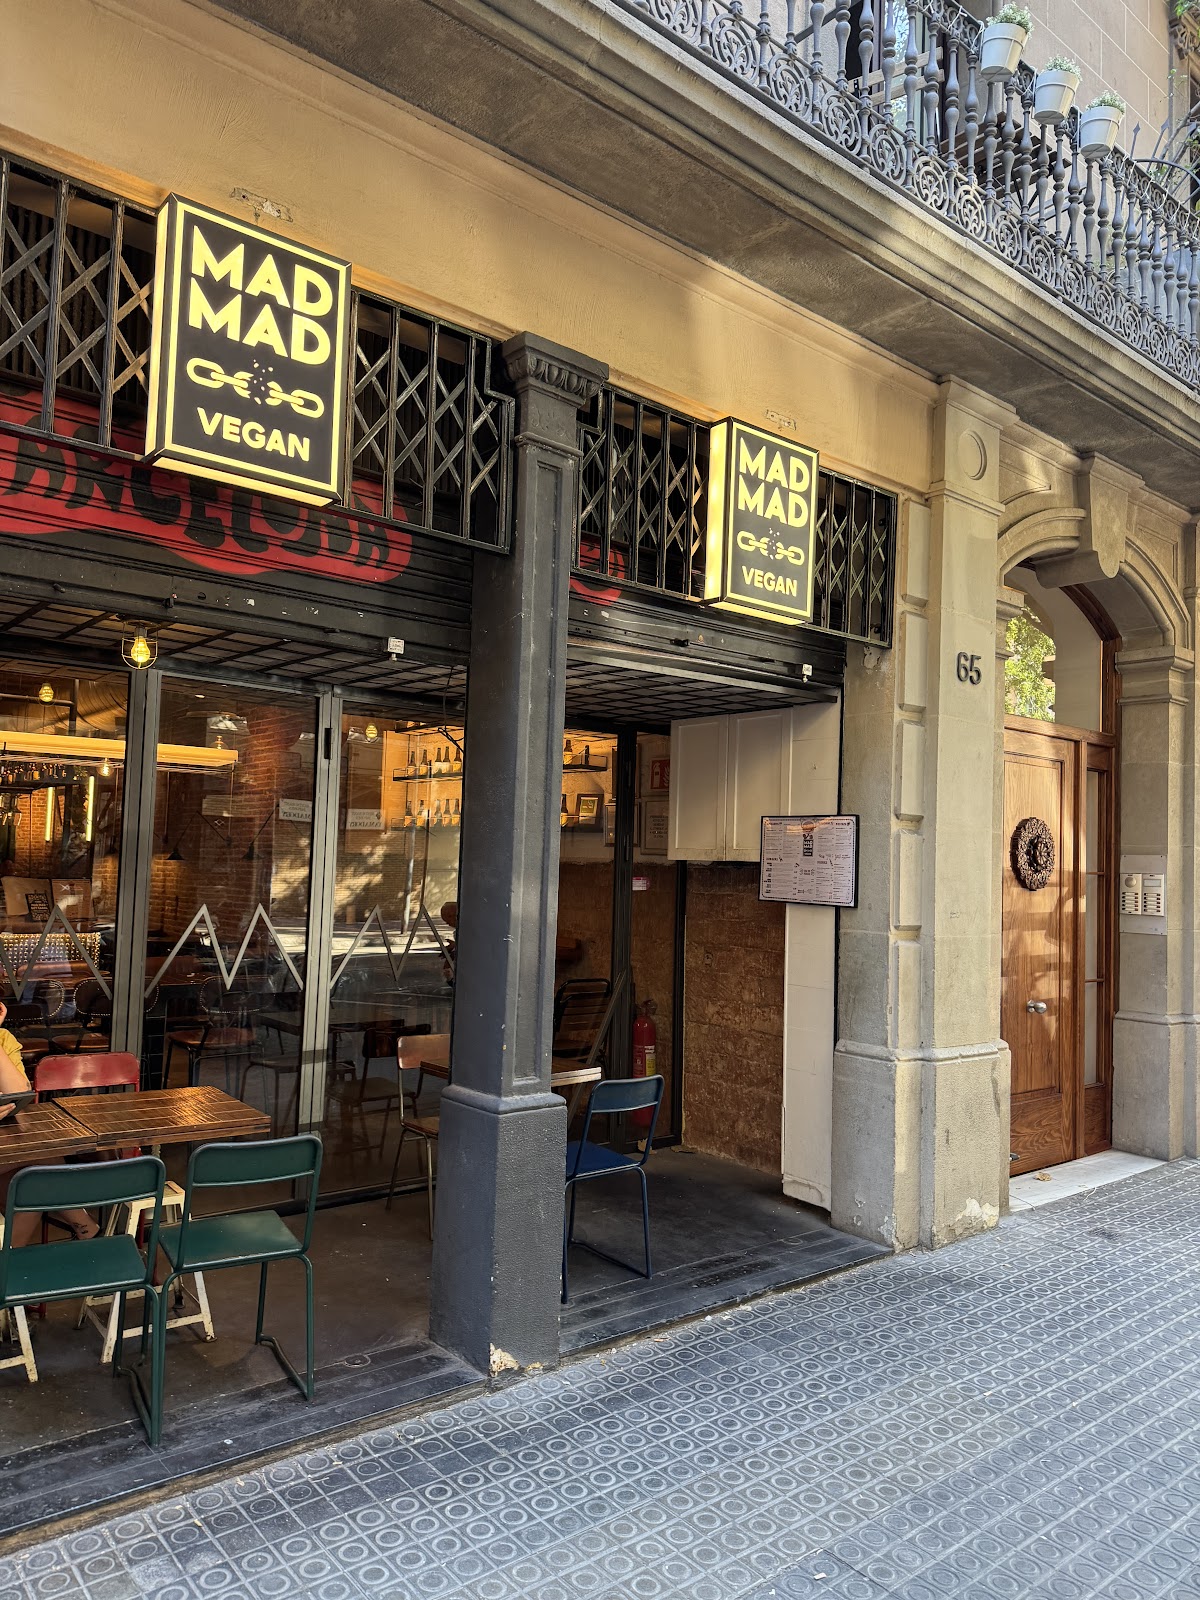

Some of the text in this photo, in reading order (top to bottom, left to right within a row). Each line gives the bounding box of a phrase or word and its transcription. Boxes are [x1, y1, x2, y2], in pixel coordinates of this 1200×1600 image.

[191, 225, 334, 317] MAD
[188, 277, 331, 365] MAD
[196, 406, 310, 462] VEGAN
[739, 437, 810, 492] MAD
[737, 475, 809, 528] MAD
[742, 566, 798, 597] VEGAN
[956, 651, 981, 685] 65
